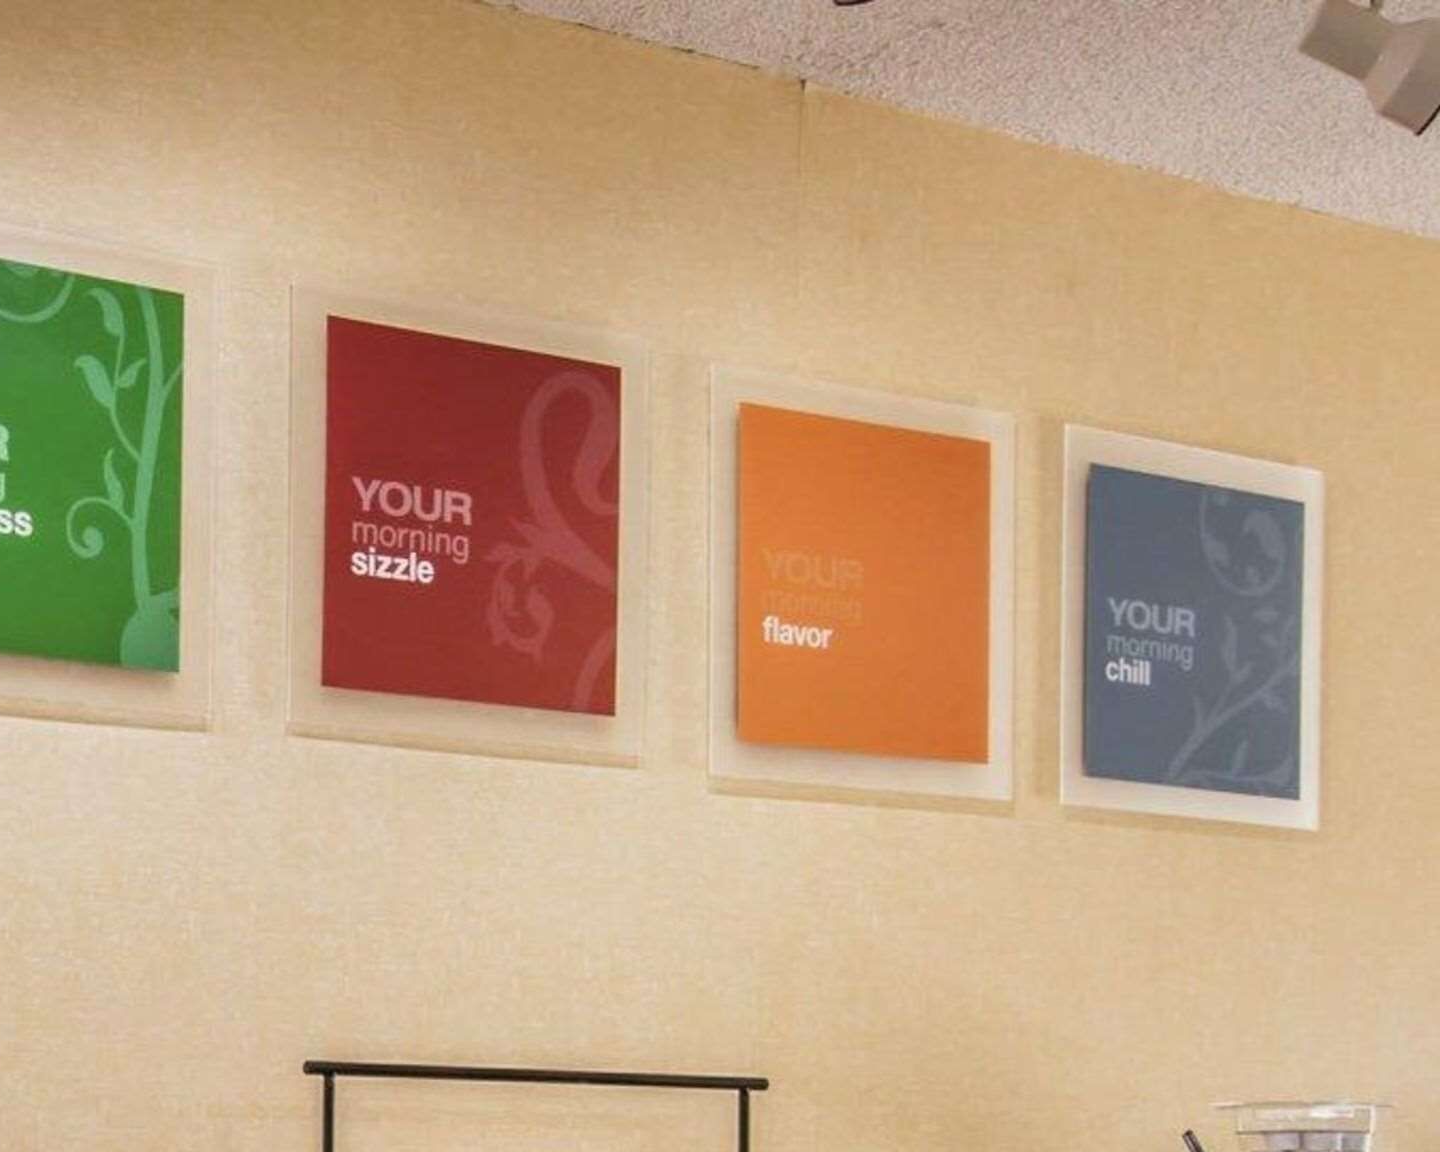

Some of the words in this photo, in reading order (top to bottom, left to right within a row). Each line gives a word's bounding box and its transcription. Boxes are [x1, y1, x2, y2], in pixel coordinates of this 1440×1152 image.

[352, 476, 472, 526] YOUR
[351, 522, 470, 565] morning
[351, 546, 435, 584] sizzle
[761, 547, 865, 592] YOUR
[762, 615, 834, 649] flavor
[1106, 597, 1195, 638] YOUR
[1105, 657, 1151, 686] chill
[1106, 635, 1194, 672] morning
